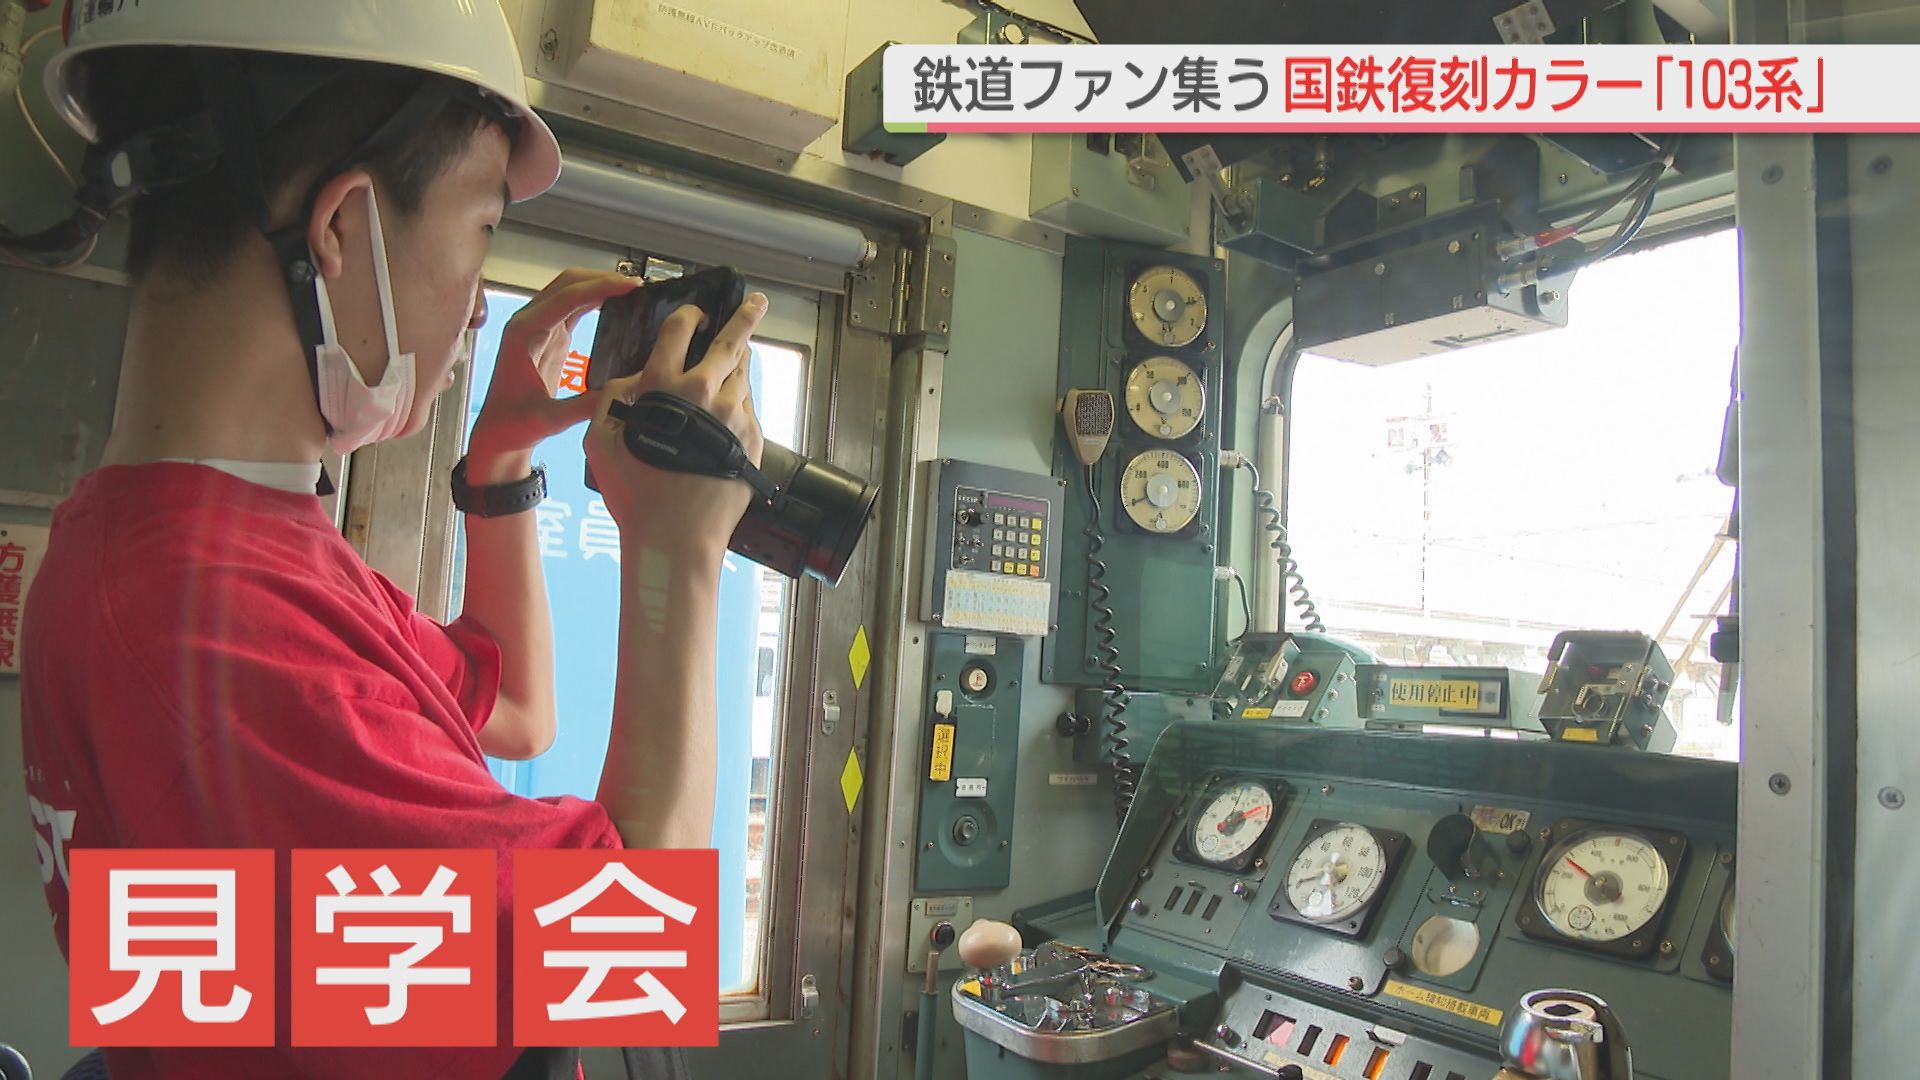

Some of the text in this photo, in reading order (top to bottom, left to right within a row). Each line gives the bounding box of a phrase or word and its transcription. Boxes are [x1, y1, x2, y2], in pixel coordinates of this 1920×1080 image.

[1392, 682, 1477, 704] 使用停止中
